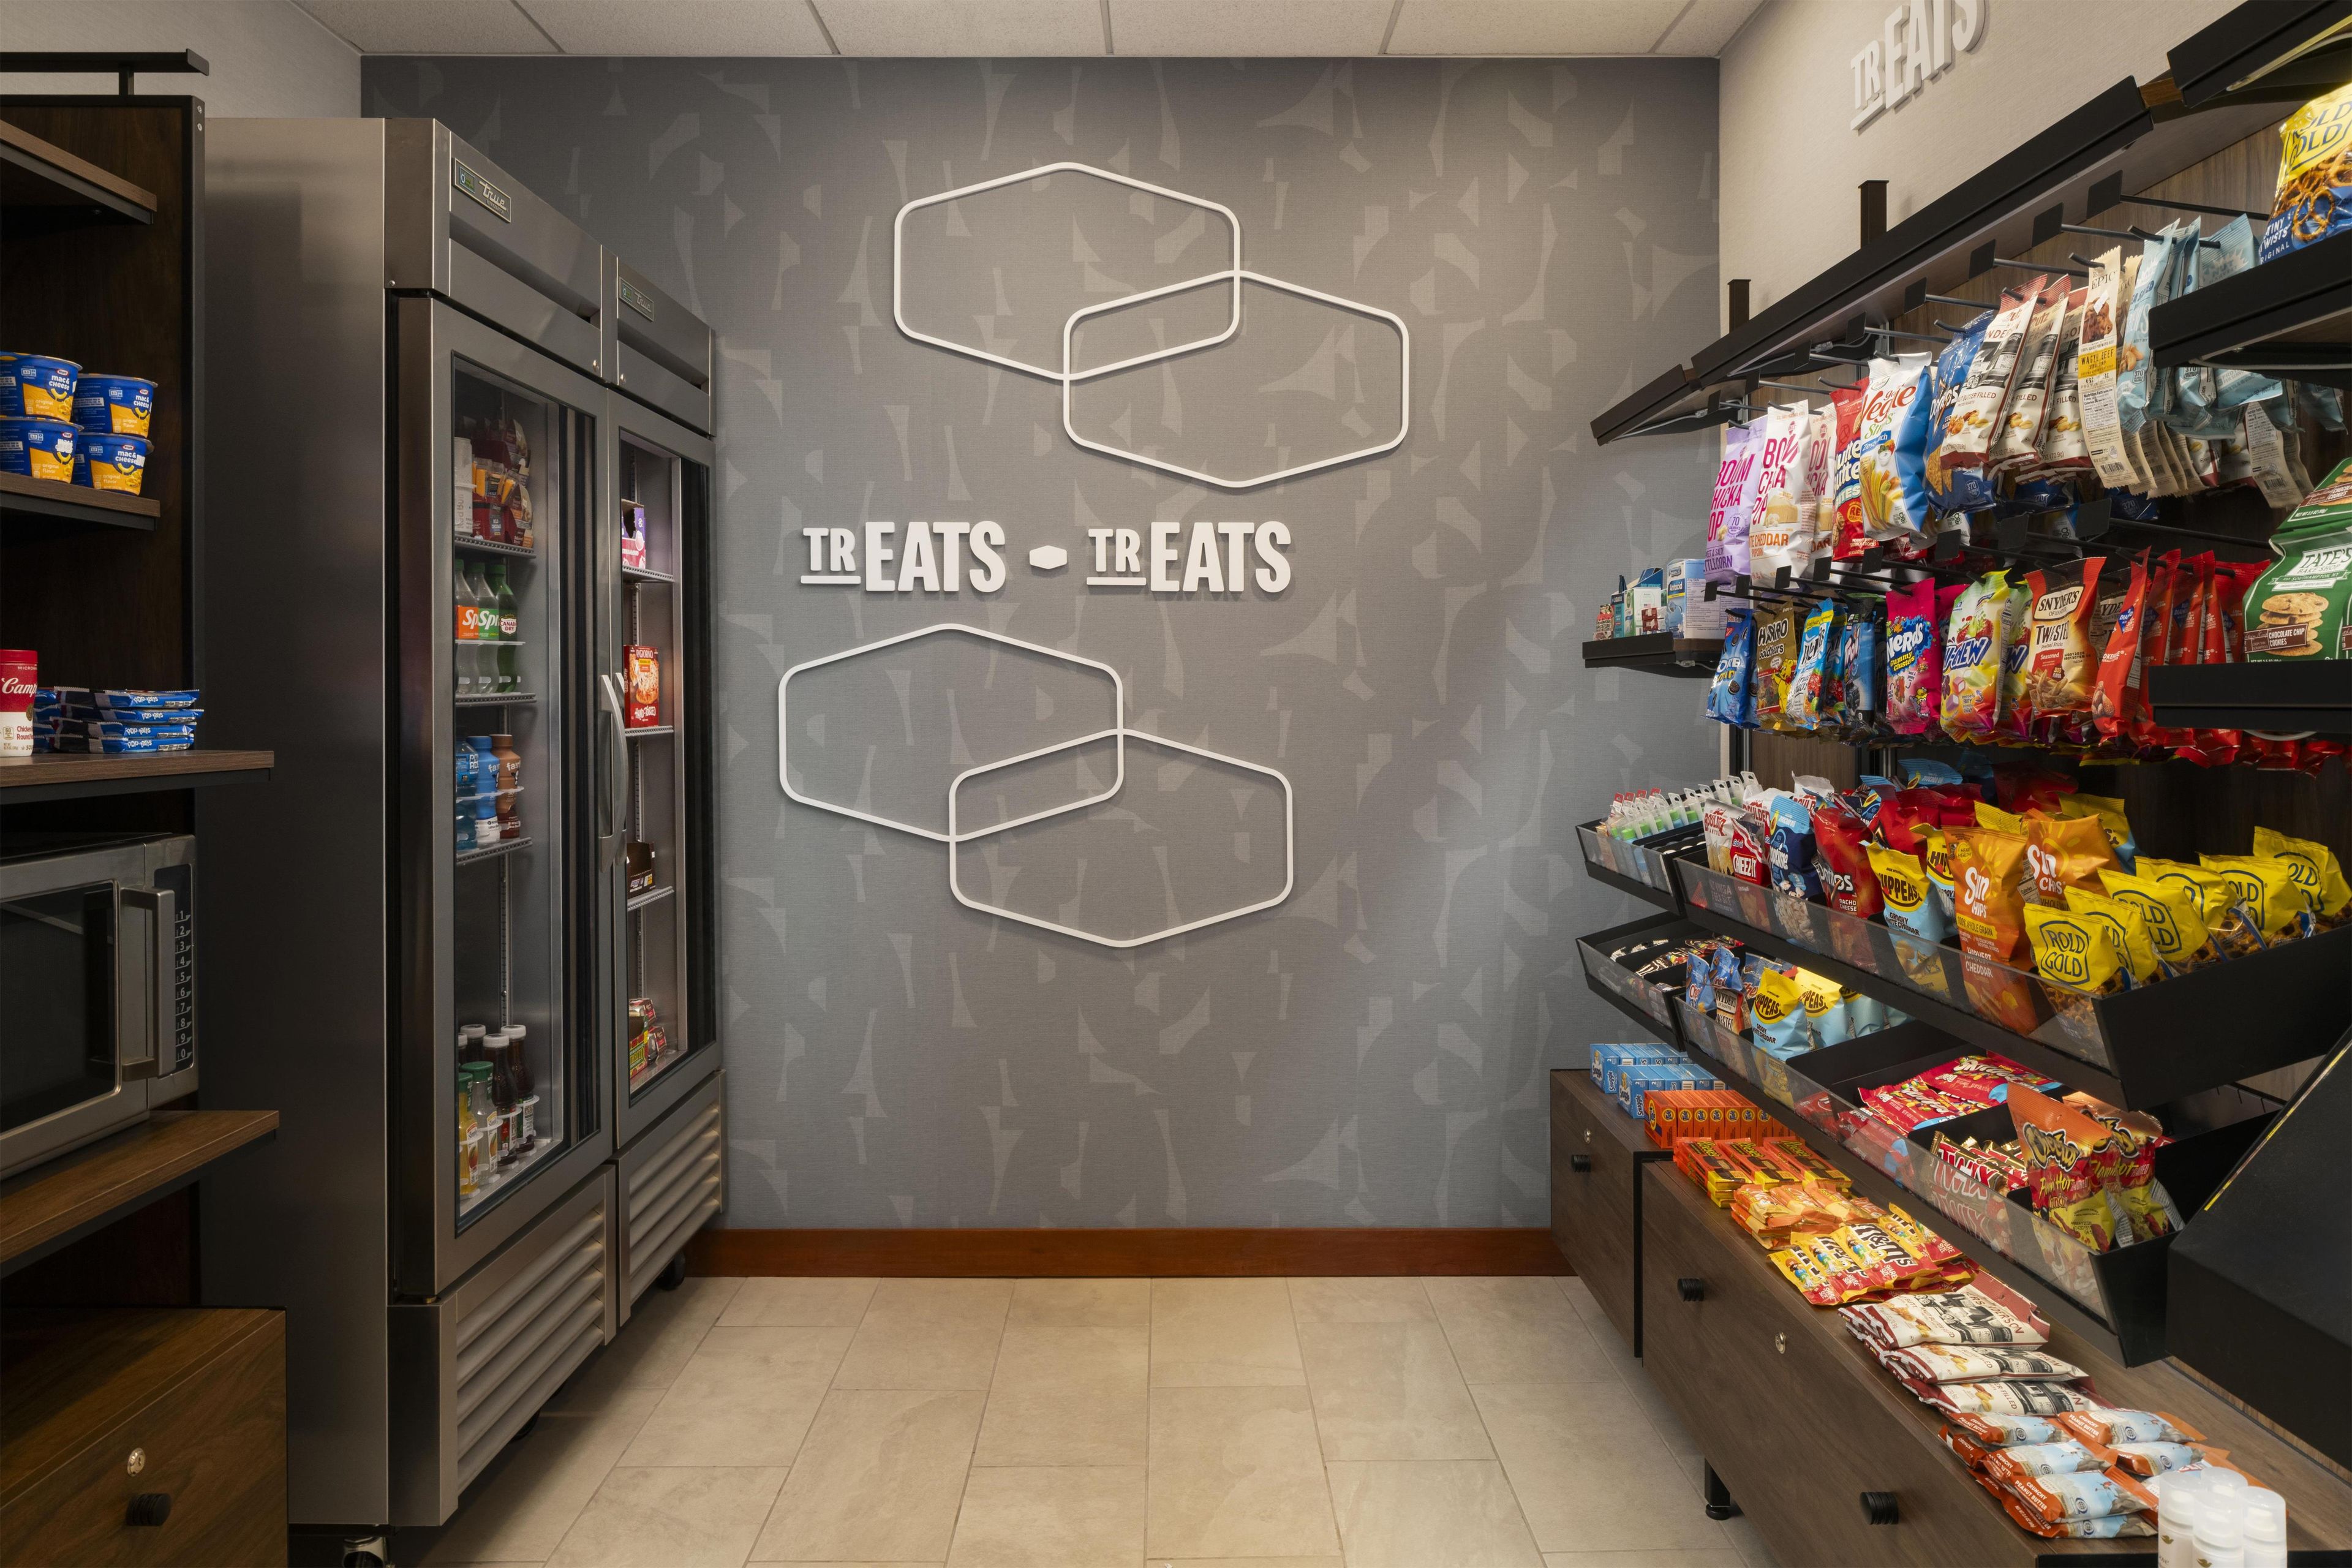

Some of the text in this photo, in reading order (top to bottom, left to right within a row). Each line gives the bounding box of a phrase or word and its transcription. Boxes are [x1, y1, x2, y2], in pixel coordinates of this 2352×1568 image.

[2266, 217, 2285, 236] TINY
[2092, 271, 2115, 290] EPIC
[1711, 484, 1743, 510] HICKA
[1708, 511, 1724, 542] OP
[1732, 516, 1740, 526] 70
[801, 520, 1291, 593] TREATS TREATS
[2038, 590, 2080, 611] SNYDER'S
[1757, 618, 1789, 647] HARIBO
[2269, 628, 2305, 639] CHOCOLATE CHIP
[2269, 638, 2288, 647] COOKIES
[1890, 650, 1913, 667] Gummy
[2040, 652, 2060, 660] Seasoned
[1893, 655, 1915, 672] Clusters
[180, 910, 183, 919] 1
[179, 925, 184, 935] 2
[1979, 925, 1993, 937] GRAIN
[180, 941, 184, 951] 3
[2046, 930, 2086, 954] ROLD
[180, 956, 185, 965] 4
[2046, 951, 2082, 978] GOLD
[180, 972, 185, 981] 5
[1966, 961, 1993, 978] CHEDDAR
[180, 987, 185, 997] 6
[181, 1003, 185, 1012] 7
[181, 1018, 186, 1028] 8
[181, 1033, 186, 1043] 9
[181, 1049, 186, 1058] 0
[1607, 1070, 1616, 1092] Snuggle
[1635, 1094, 1644, 1117] Snuggle
[1883, 1264, 1898, 1279] SHARE
[1959, 1417, 1973, 1428] PEANUT
[1970, 1418, 1988, 1430] CRUNCHY
[2069, 1414, 2100, 1437] PEANUT BUTTER
[2079, 1415, 2099, 1428] CRUNCHY
[1958, 1438, 1974, 1452] CRUNCHY
[1996, 1453, 2014, 1469] CRUNCHY
[2015, 1480, 2048, 1511] PEANUT BUTTER
[2026, 1481, 2048, 1501] CRUNCHY
